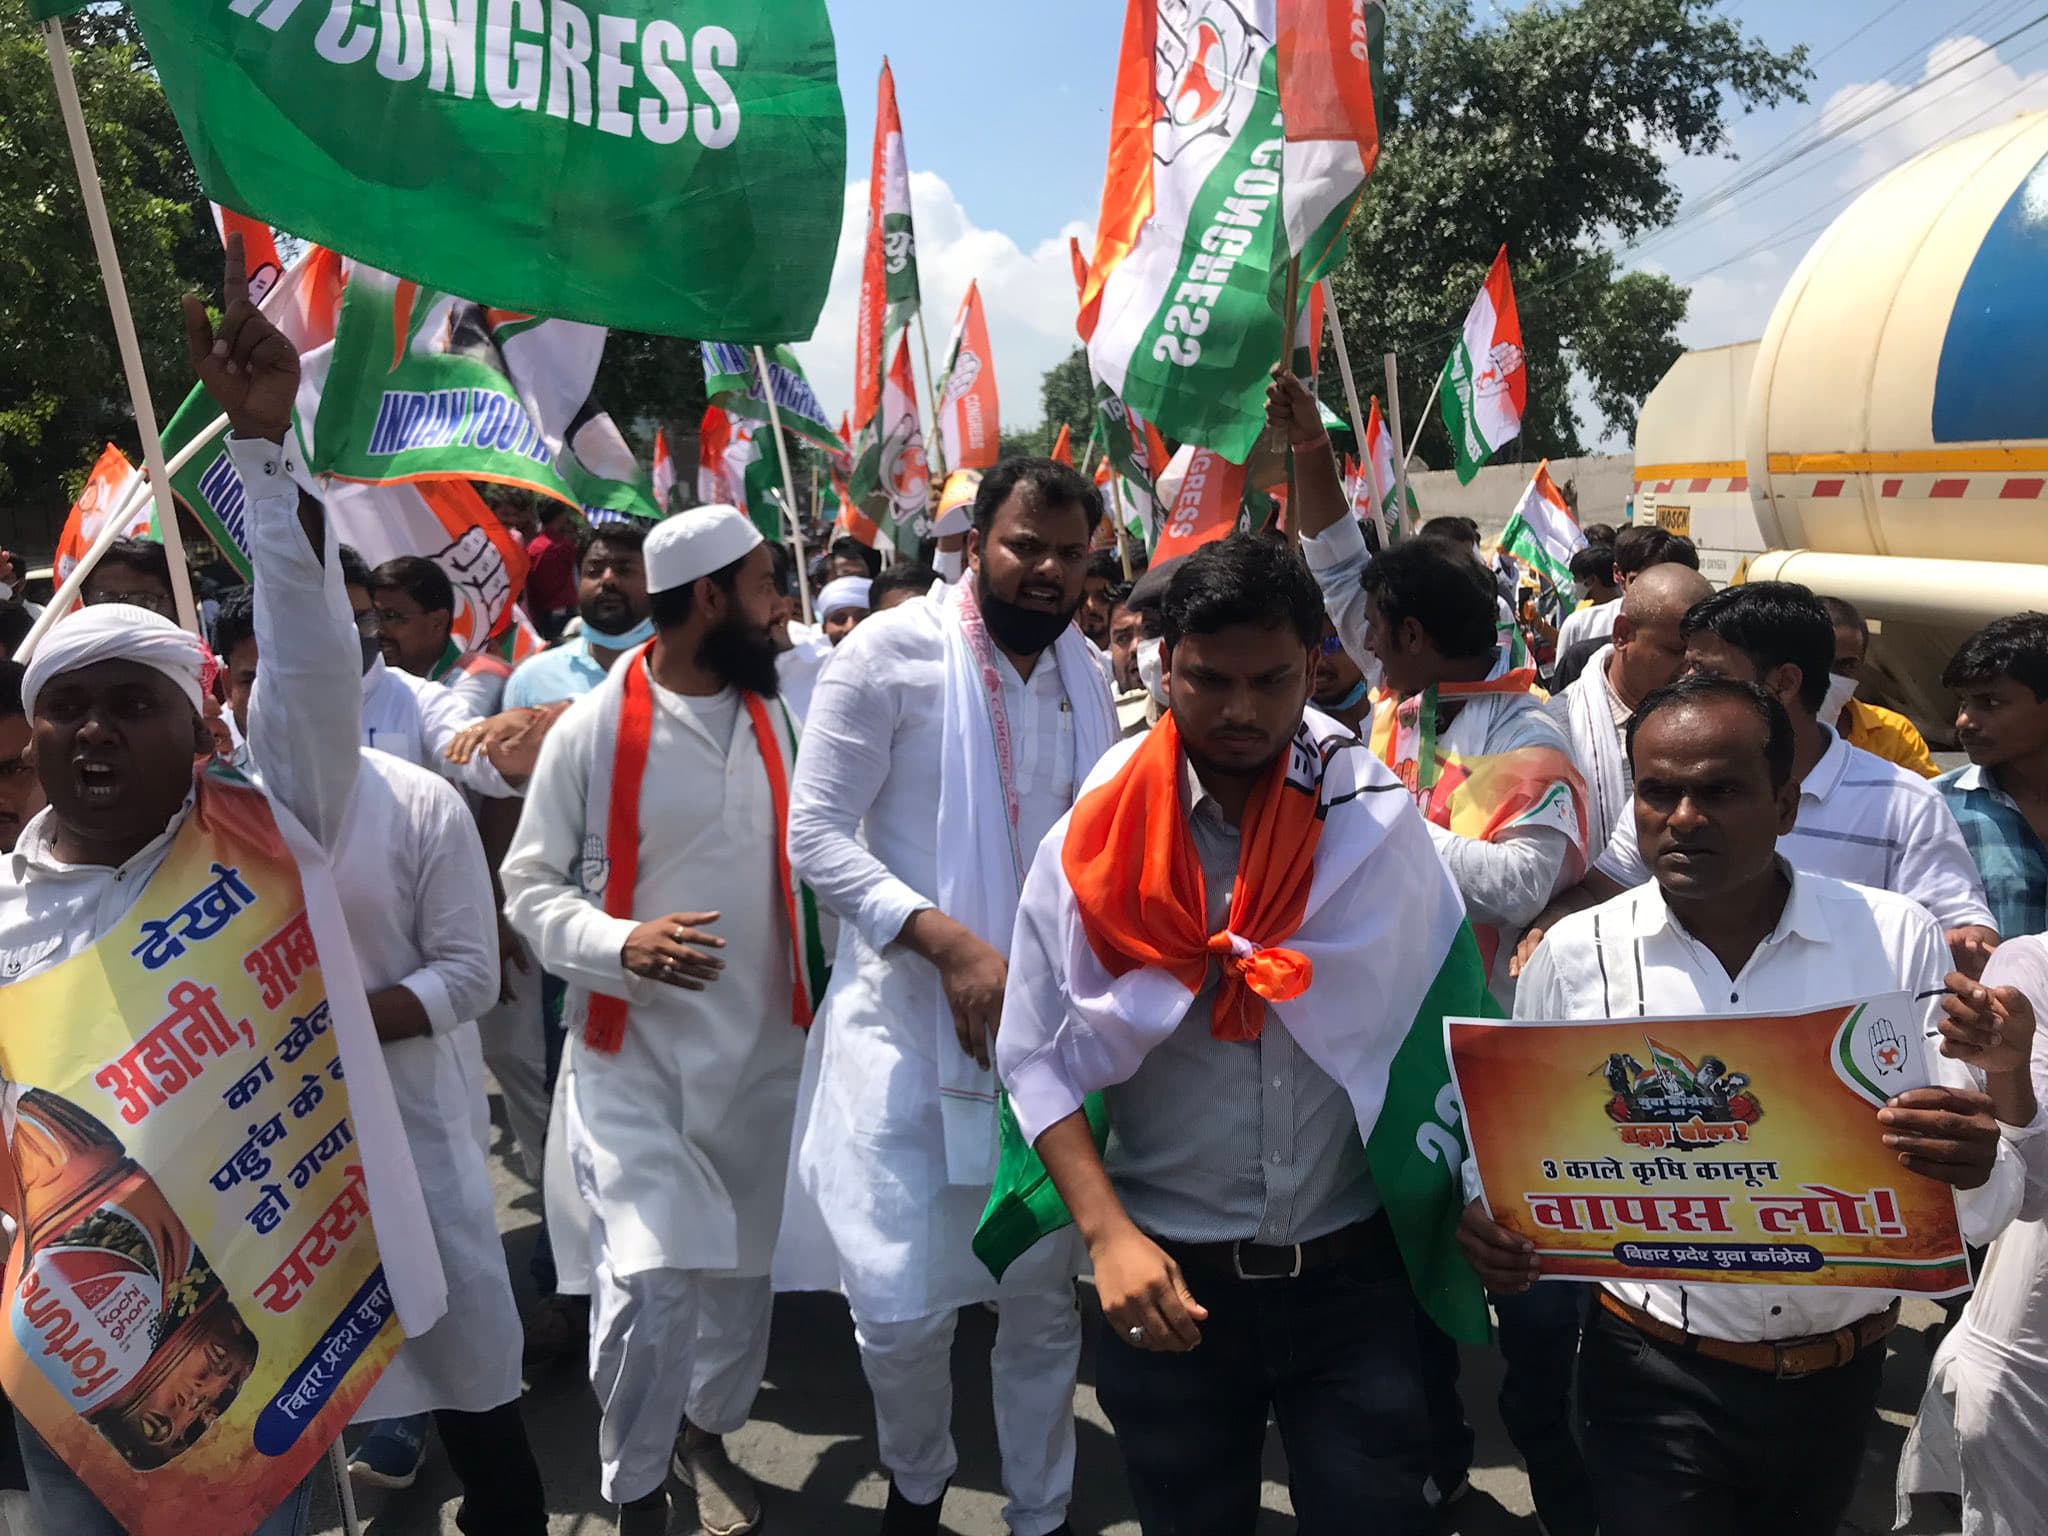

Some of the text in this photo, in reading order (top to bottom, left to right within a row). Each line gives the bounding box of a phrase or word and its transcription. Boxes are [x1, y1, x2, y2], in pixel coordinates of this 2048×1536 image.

[313, 0, 741, 149] CONGRESS
[366, 389, 468, 456] INDIAN
[131, 863, 257, 970] देखो
[97, 979, 256, 1125] अडानी,
[223, 1056, 274, 1110] का
[209, 1074, 324, 1191] पहुंच के
[245, 1117, 353, 1235] हो गया
[1544, 1157, 1778, 1187] 3 काले कृषि कानून
[1527, 1186, 1901, 1234] वापस लो!
[1623, 1246, 1811, 1268] बिहार प्रदेश युवा कांग्रेस
[22, 1271, 119, 1397] fortune
[97, 1284, 140, 1328] kachi
[110, 1293, 150, 1341] ghani
[277, 1282, 390, 1420] बिहार प्रदेश युवा
